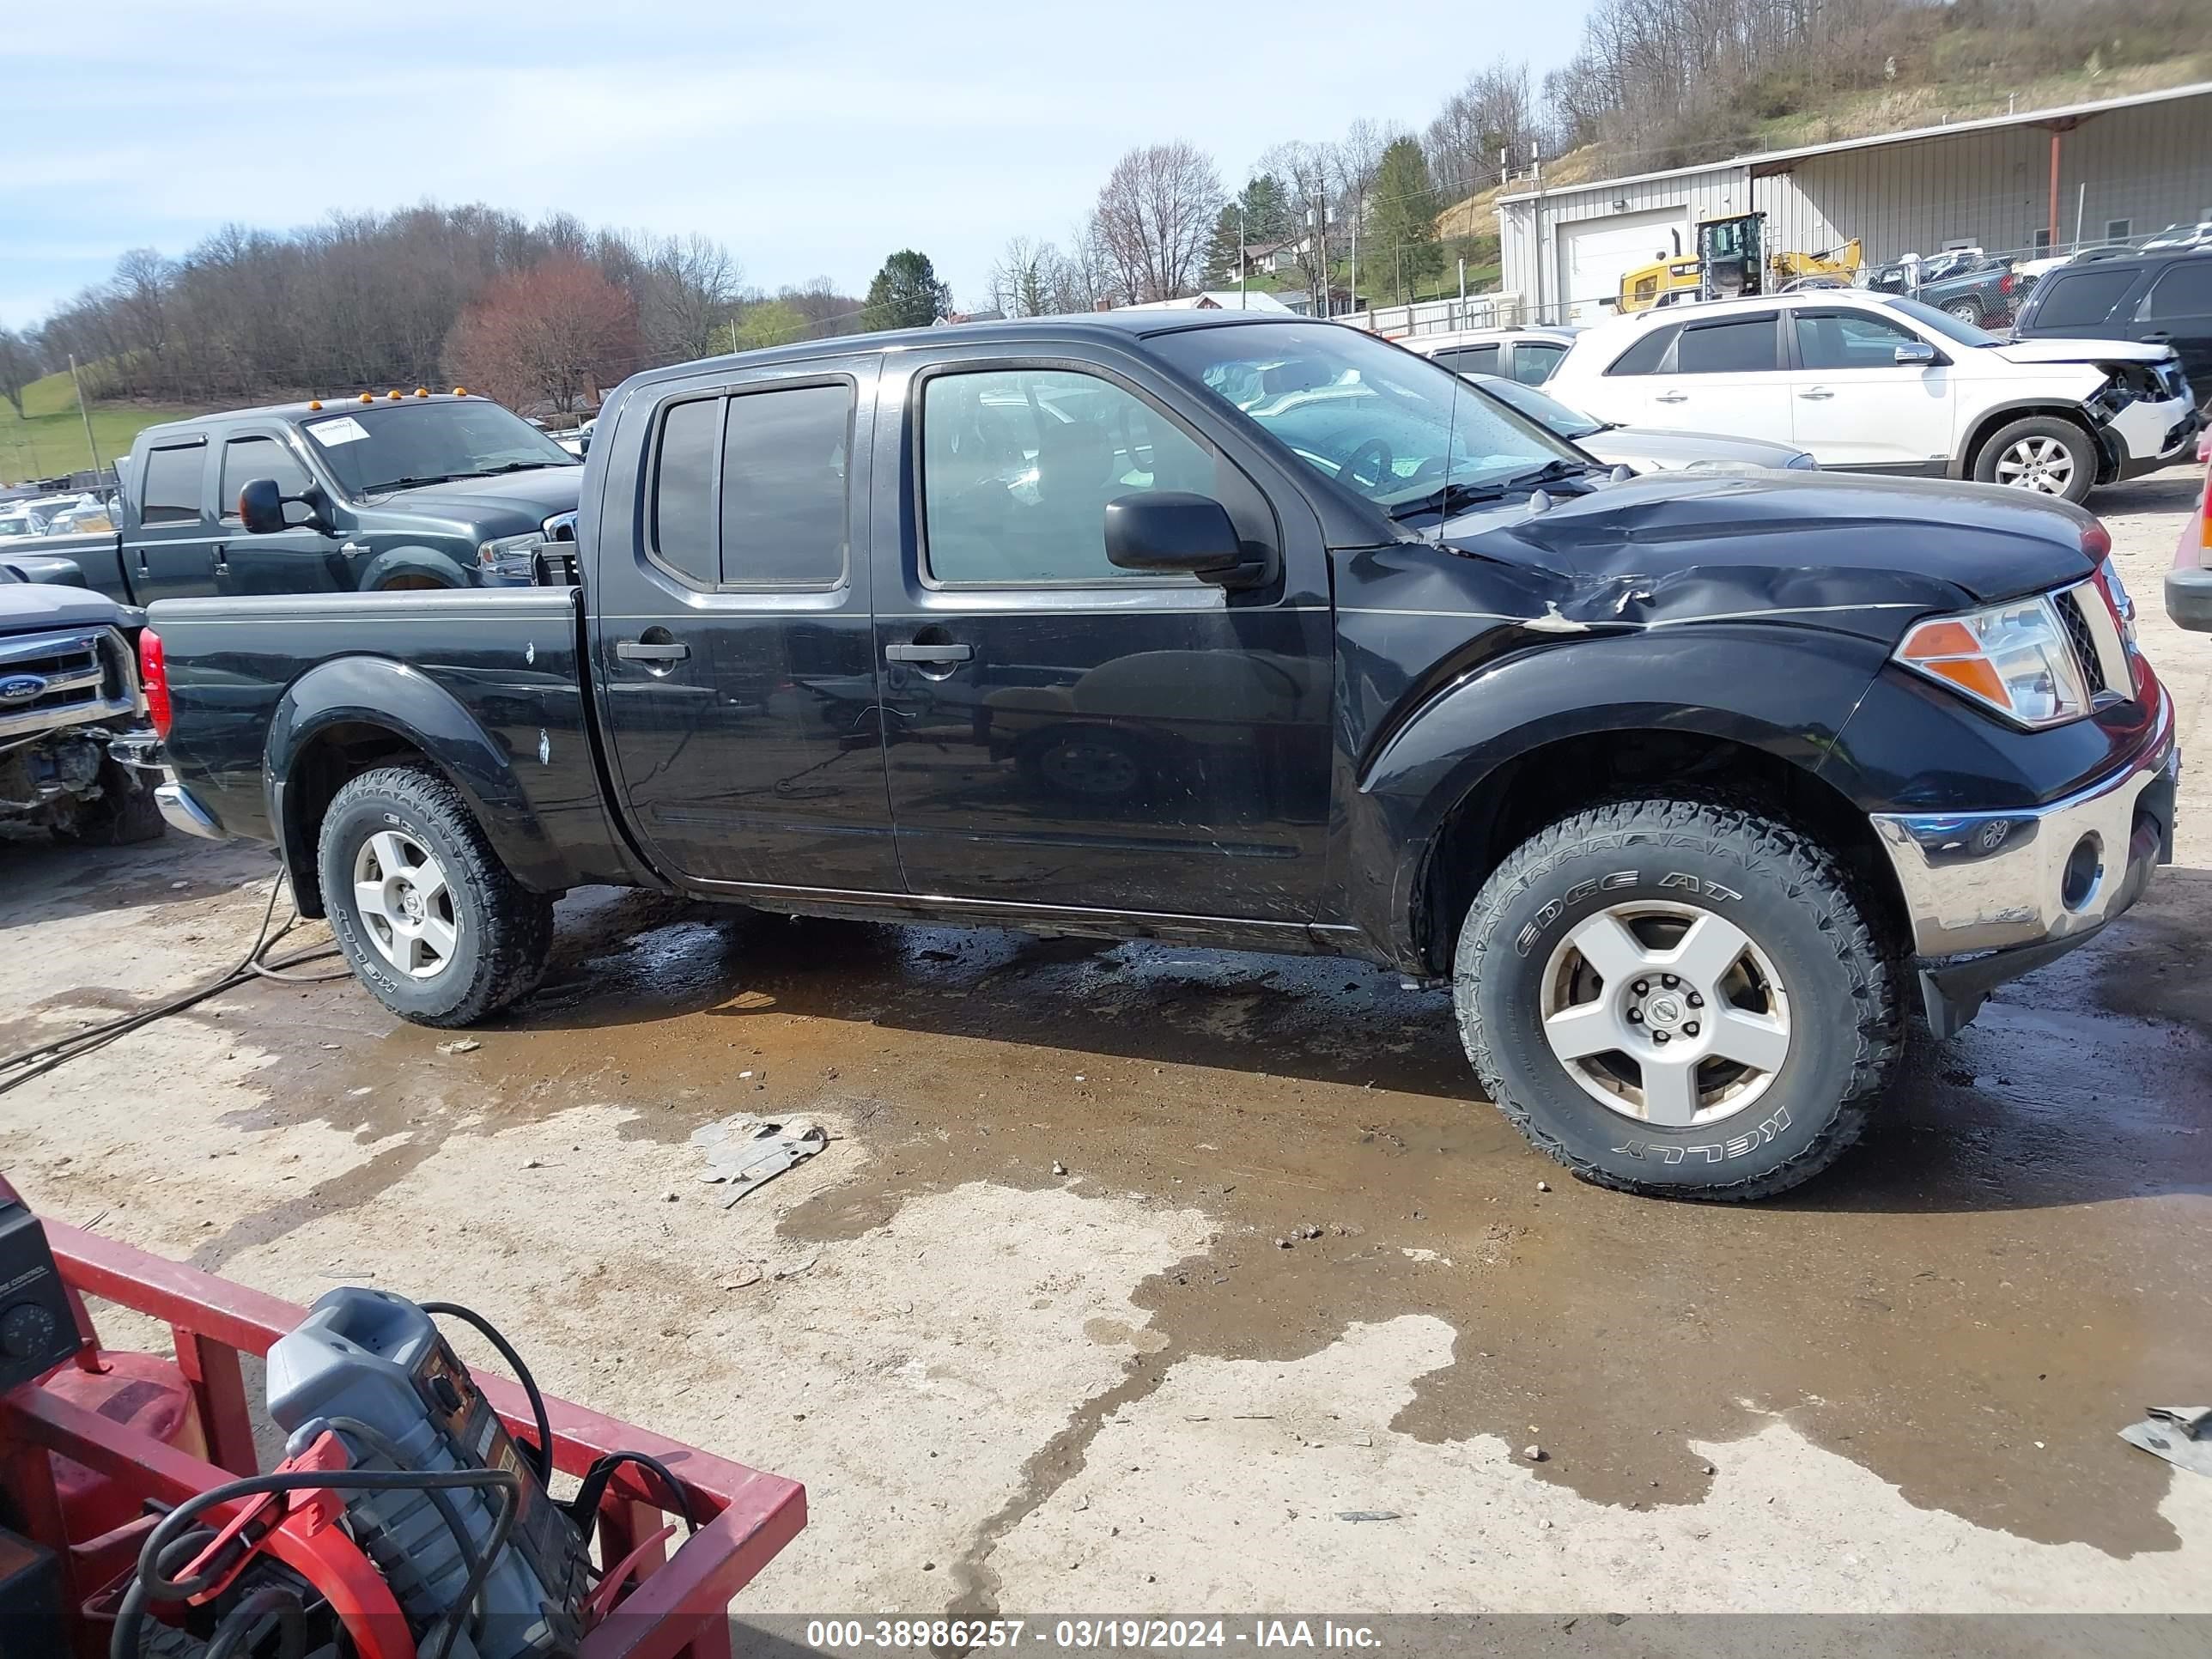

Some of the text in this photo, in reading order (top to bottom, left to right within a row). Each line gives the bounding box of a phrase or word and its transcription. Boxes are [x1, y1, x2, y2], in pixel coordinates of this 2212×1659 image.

[5, 682, 36, 697] Ford
[384, 812, 465, 934] EDGE AT
[333, 902, 399, 994] KELLY
[1515, 870, 1744, 958] EDGE AT
[1610, 1105, 1793, 1165] KELLY
[10, 1265, 46, 1286] CONTROL
